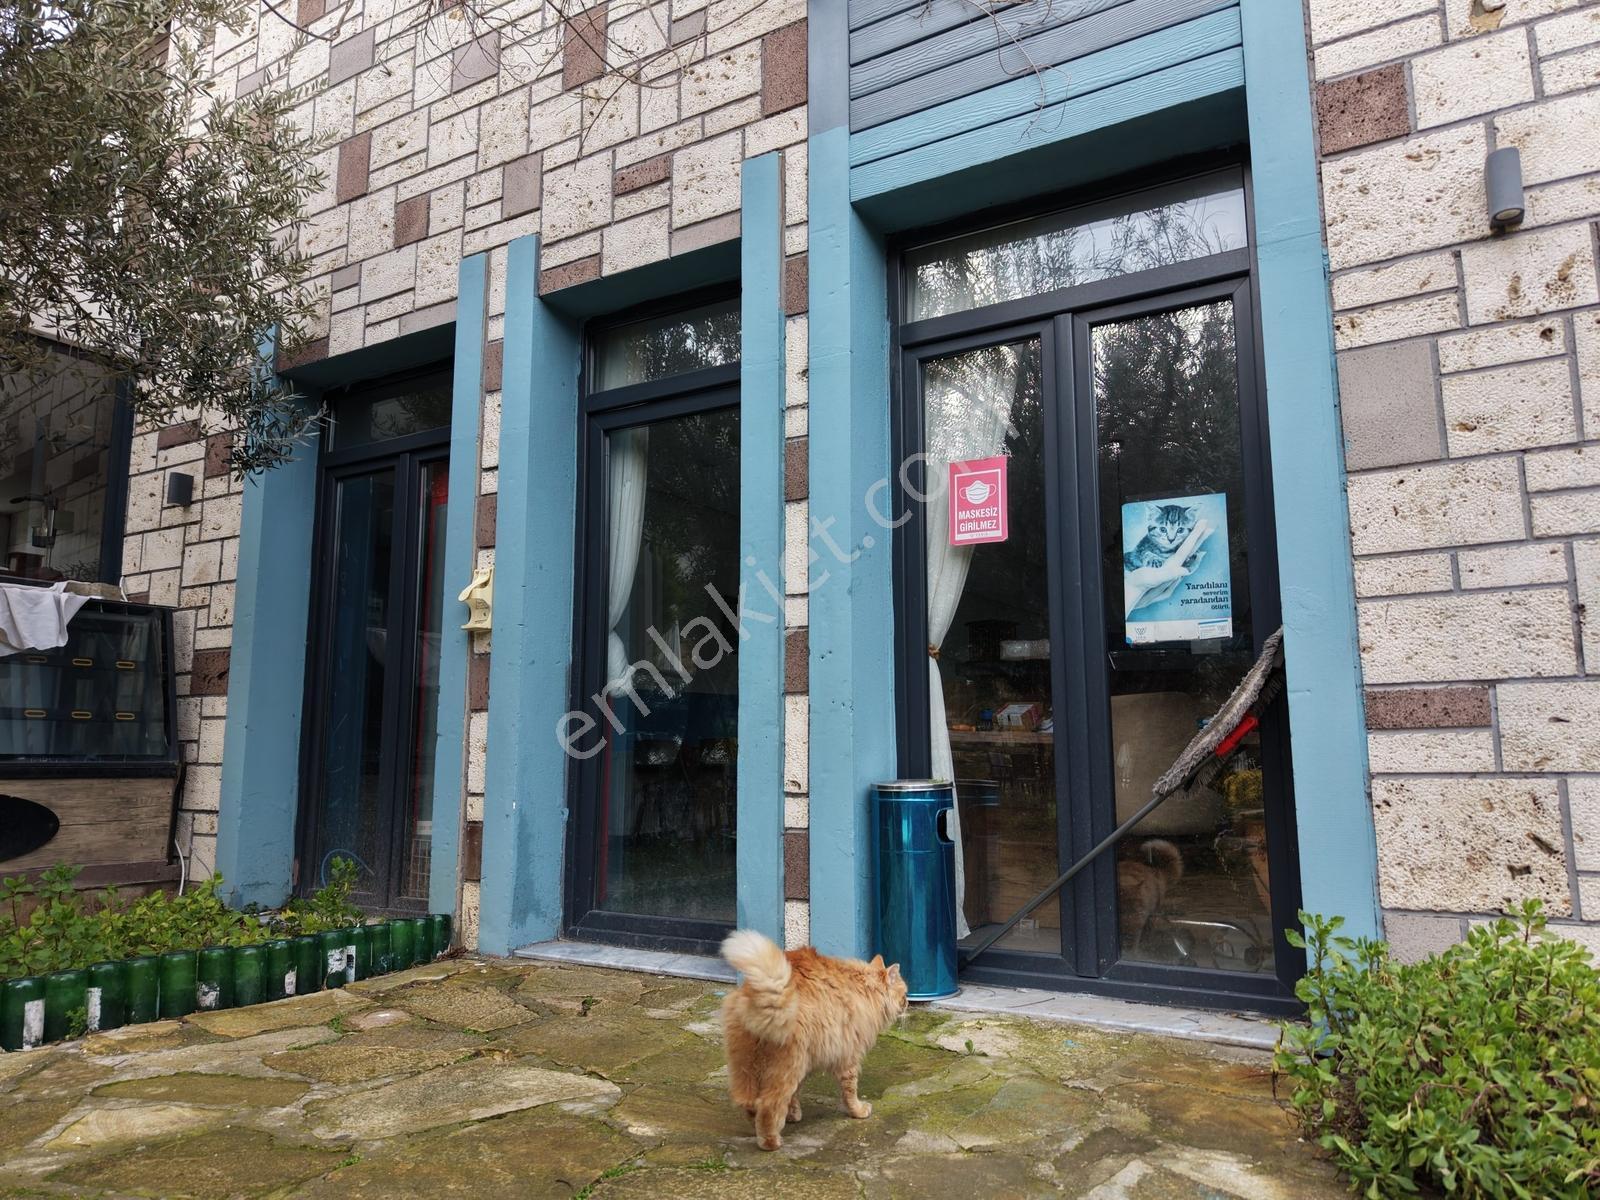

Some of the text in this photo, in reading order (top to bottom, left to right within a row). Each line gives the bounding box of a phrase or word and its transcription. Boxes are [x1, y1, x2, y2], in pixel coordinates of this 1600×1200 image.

[958, 506, 998, 520] MASKESİZ
[960, 519, 997, 532] GİRİLMEZ
[1186, 582, 1228, 590] Yaradılanı
[1180, 596, 1228, 606] yaradandan
